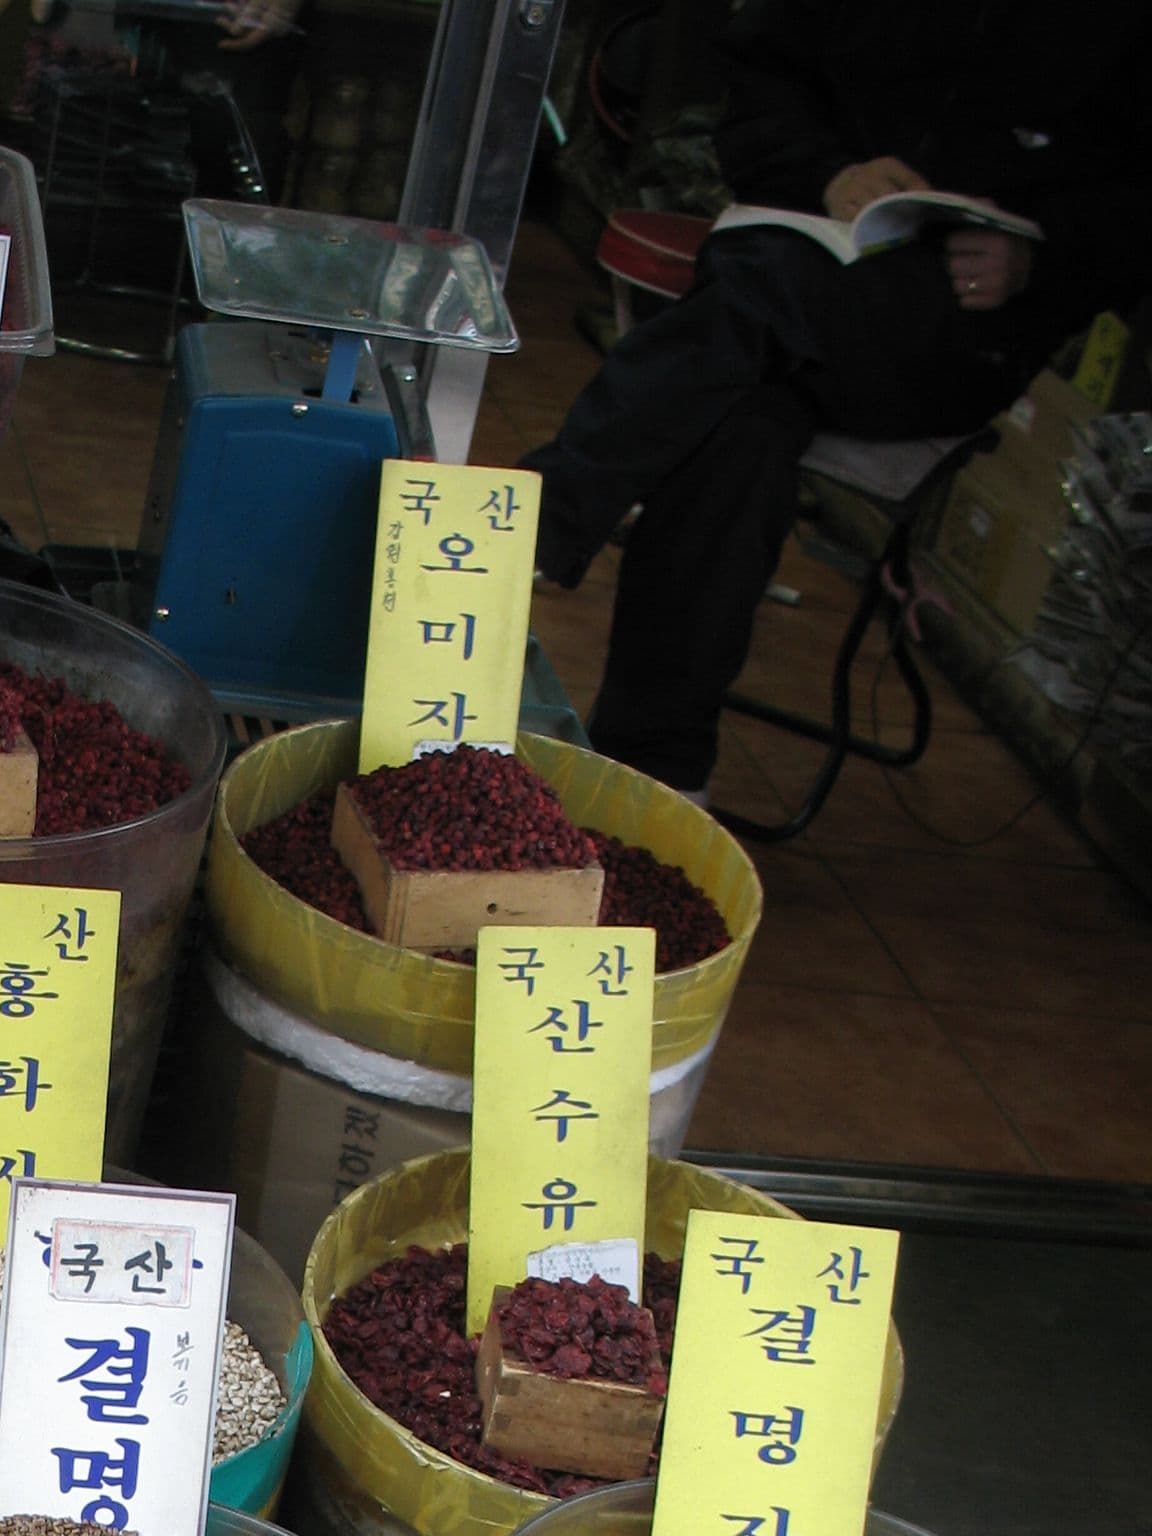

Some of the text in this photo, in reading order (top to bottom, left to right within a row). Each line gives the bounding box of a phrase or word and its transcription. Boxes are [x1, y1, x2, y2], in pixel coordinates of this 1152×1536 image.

[399, 479, 521, 532] 국산
[407, 532, 489, 741] 오미자
[497, 944, 635, 997] 국산
[520, 999, 604, 1232] 산수유
[59, 1240, 173, 1295] 국산
[709, 1235, 871, 1306] 국산
